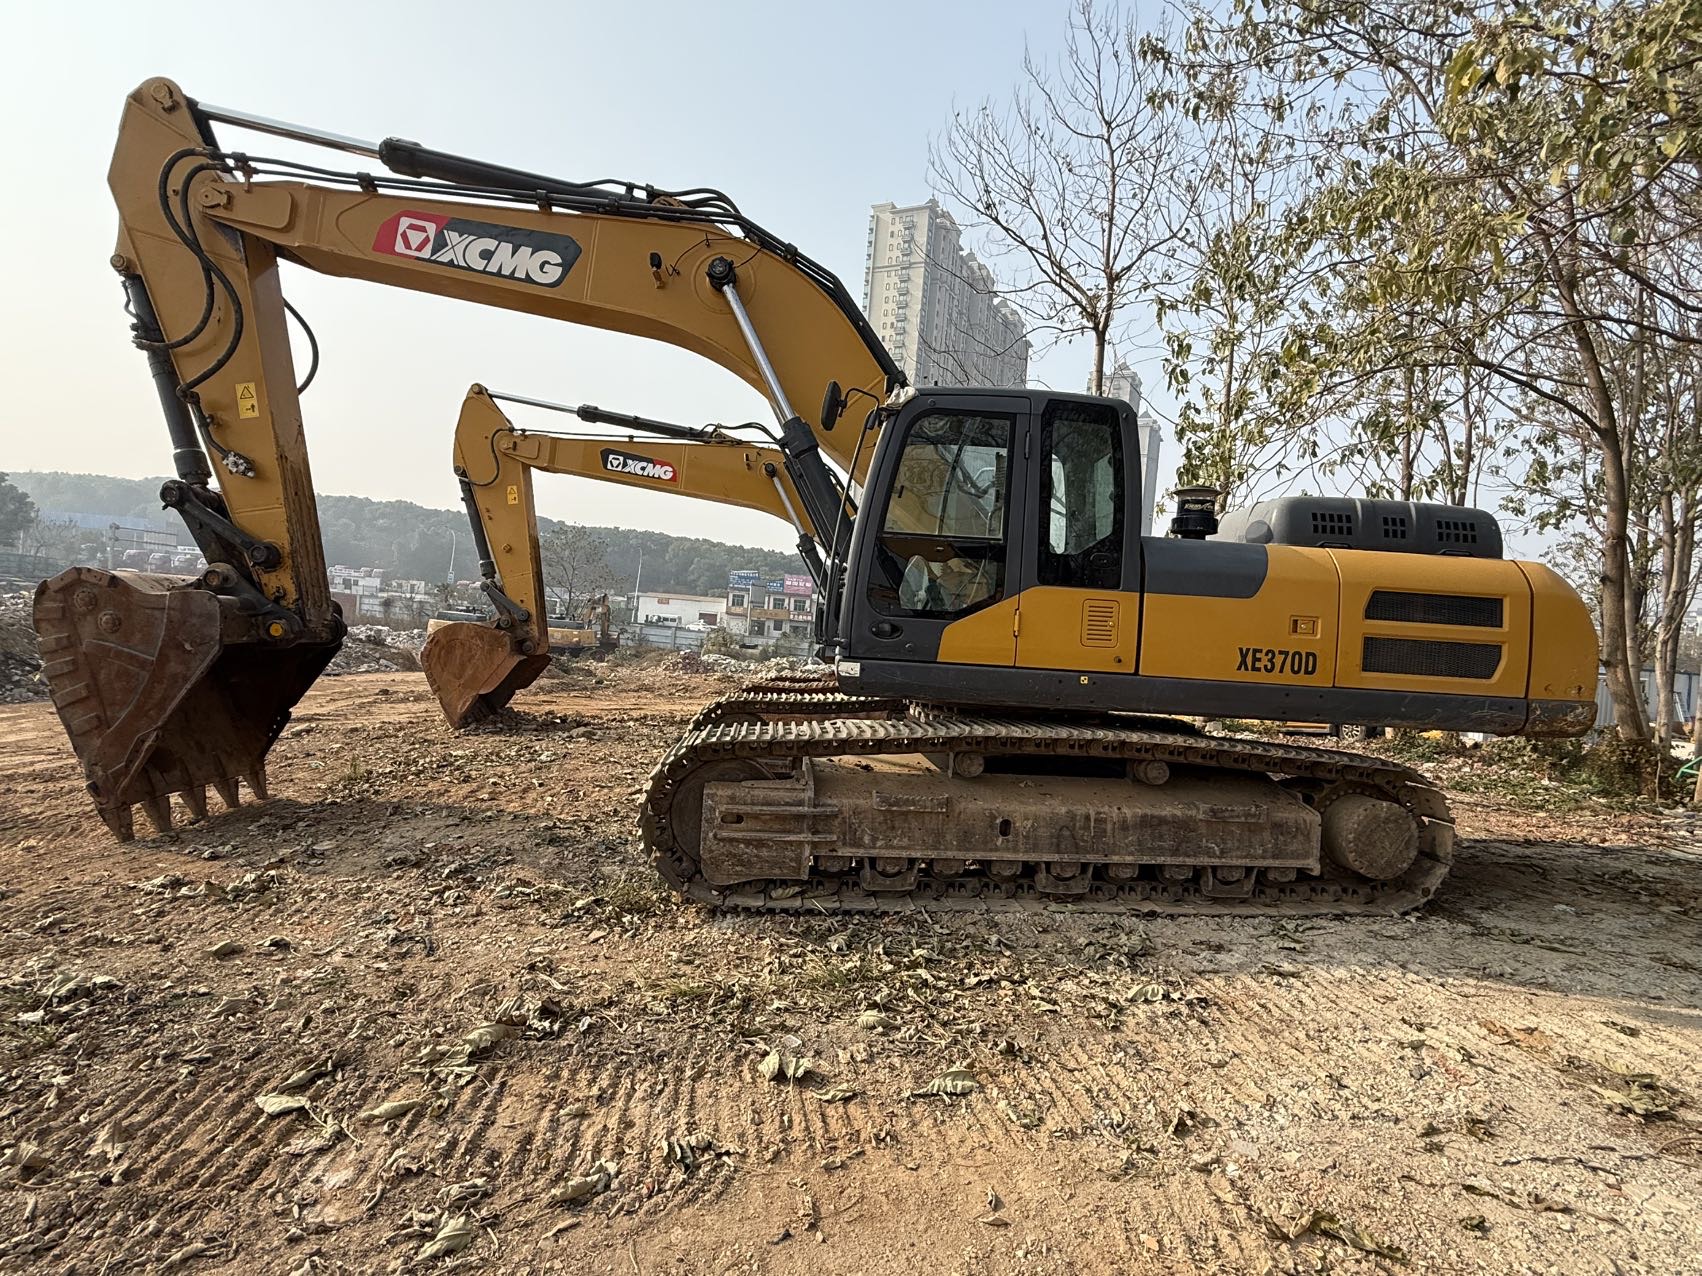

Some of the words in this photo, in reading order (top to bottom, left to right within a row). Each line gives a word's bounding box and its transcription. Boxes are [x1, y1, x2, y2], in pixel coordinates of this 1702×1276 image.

[430, 229, 563, 284] XCMG
[622, 458, 674, 480] XCMG
[1236, 647, 1318, 675] XE370D
